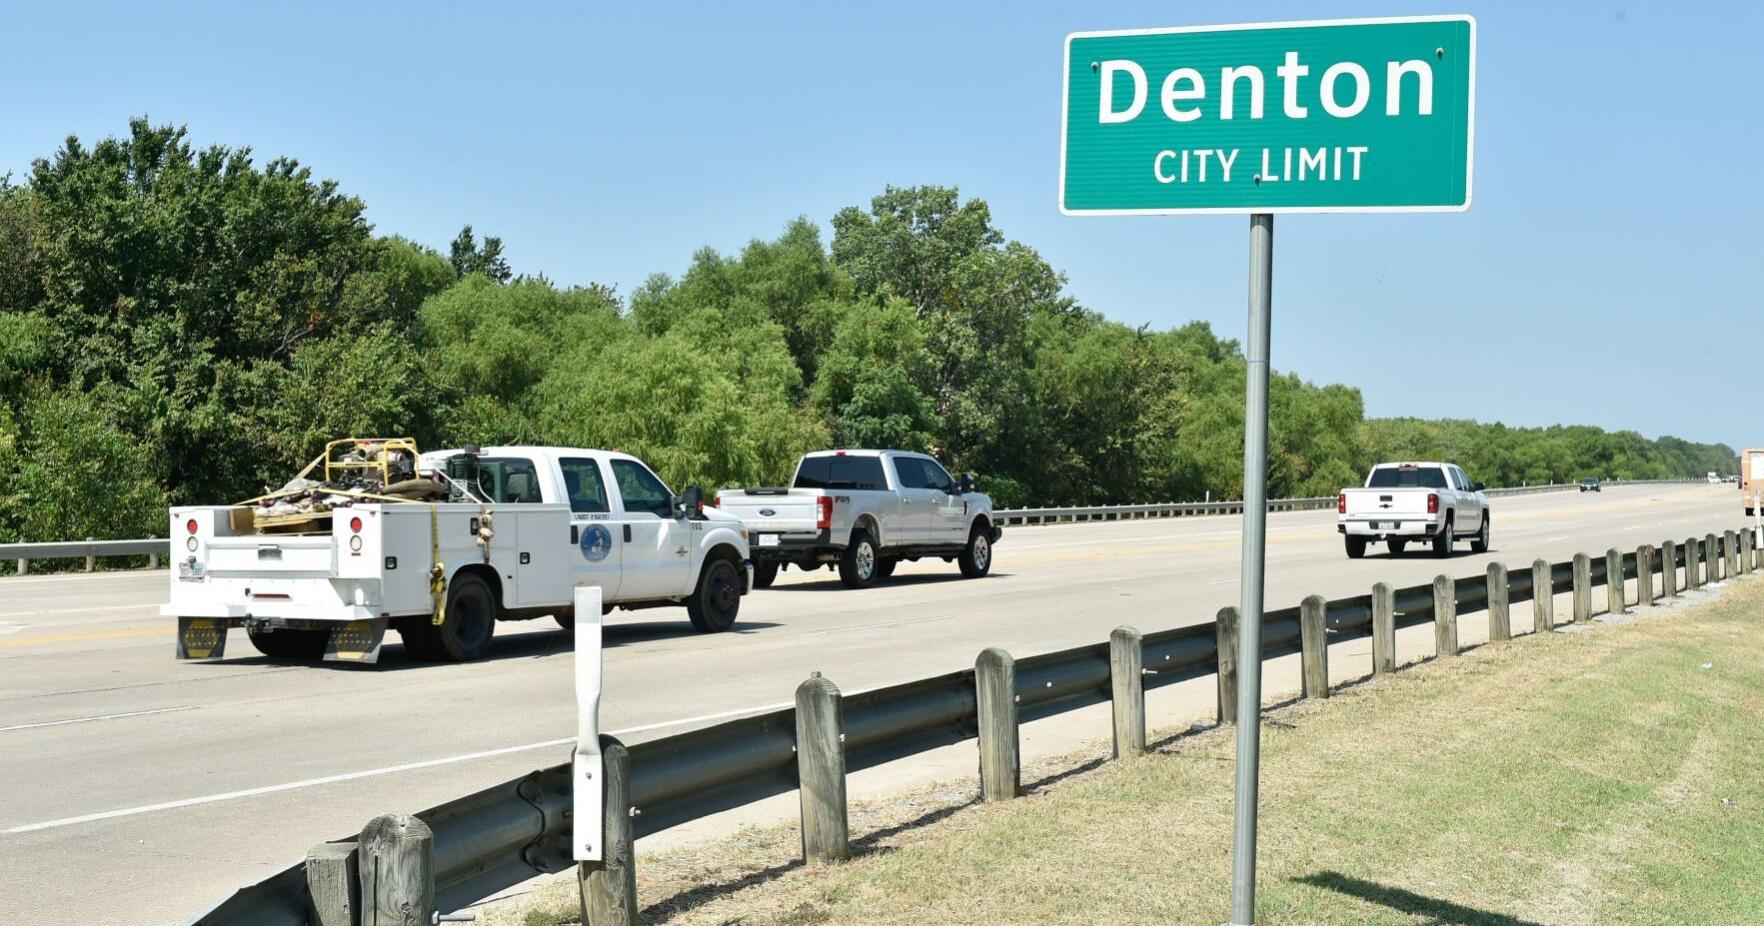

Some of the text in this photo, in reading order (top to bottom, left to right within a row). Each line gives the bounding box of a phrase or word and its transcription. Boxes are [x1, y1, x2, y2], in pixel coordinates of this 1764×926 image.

[1099, 51, 1434, 124] Denton
[1154, 146, 1368, 184] CITY LIMIT
